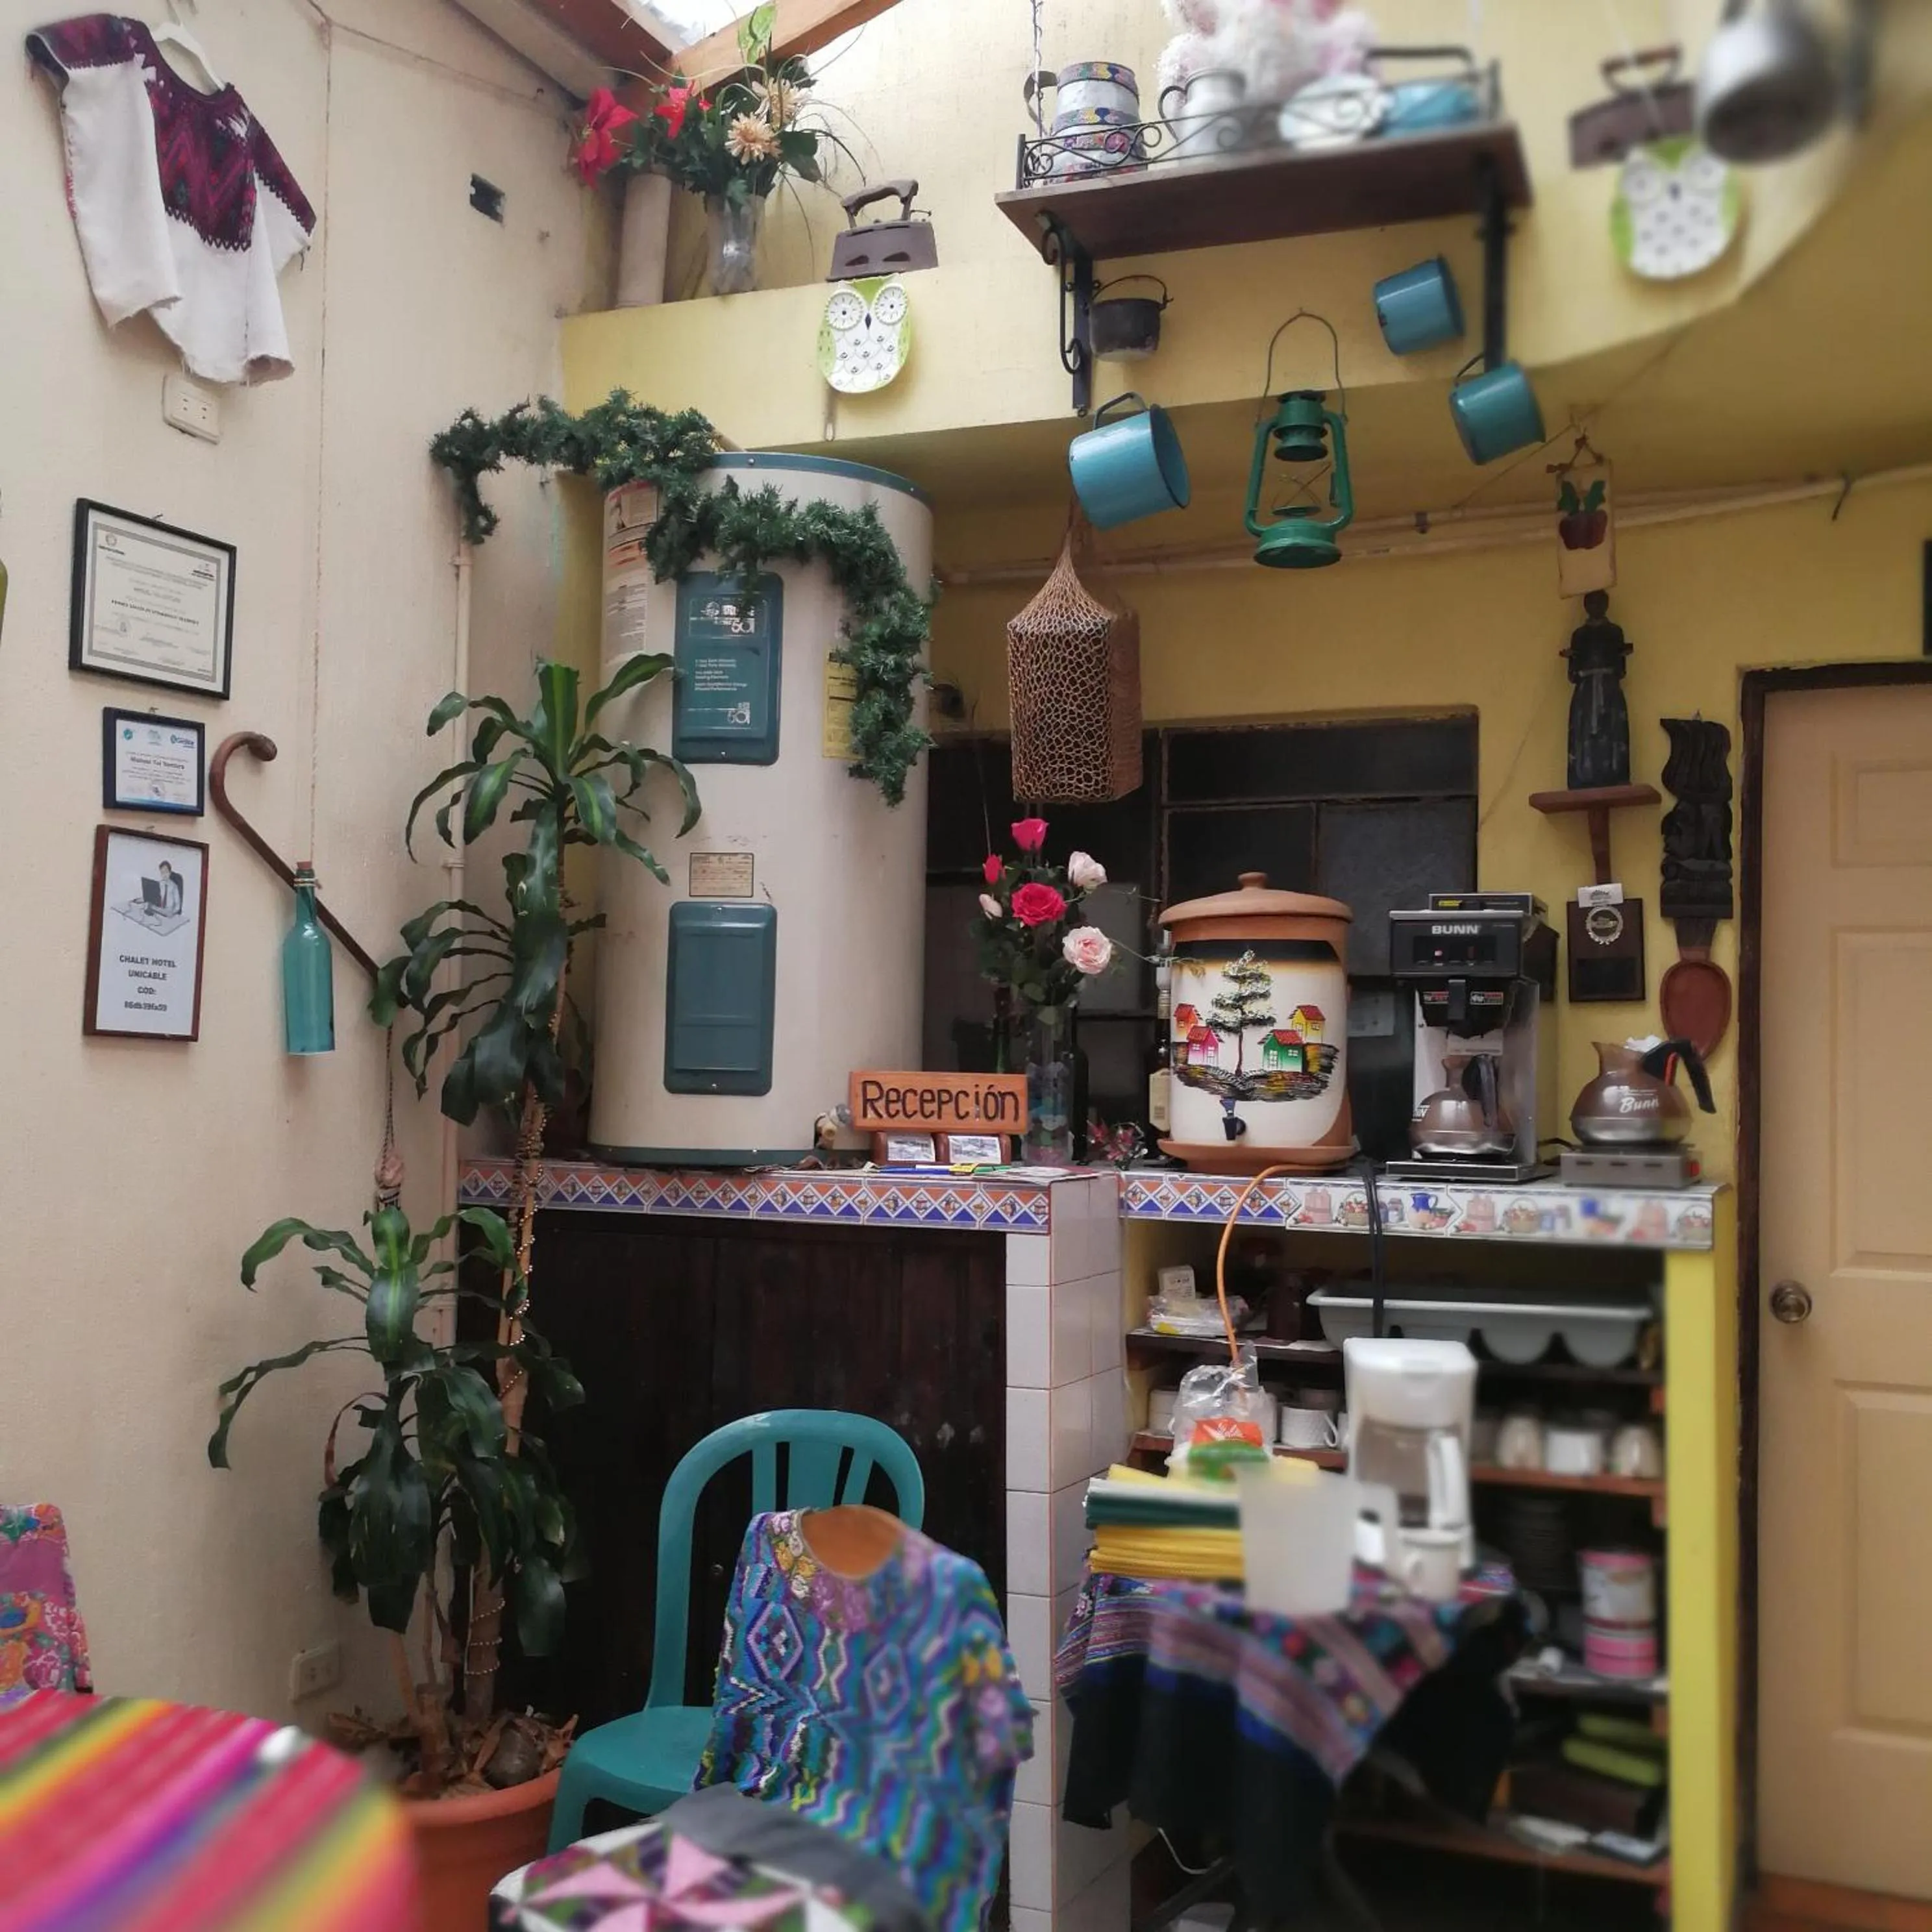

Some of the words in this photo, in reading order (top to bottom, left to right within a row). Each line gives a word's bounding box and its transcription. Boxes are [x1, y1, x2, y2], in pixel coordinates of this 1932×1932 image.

[1431, 924, 1479, 935] BUNN
[119, 954, 149, 965] CHALET
[151, 958, 177, 968] HOTEL
[129, 969, 167, 981] UNICABLE
[861, 1080, 1020, 1122] Recepción
[1619, 1096, 1659, 1113] Bunn
